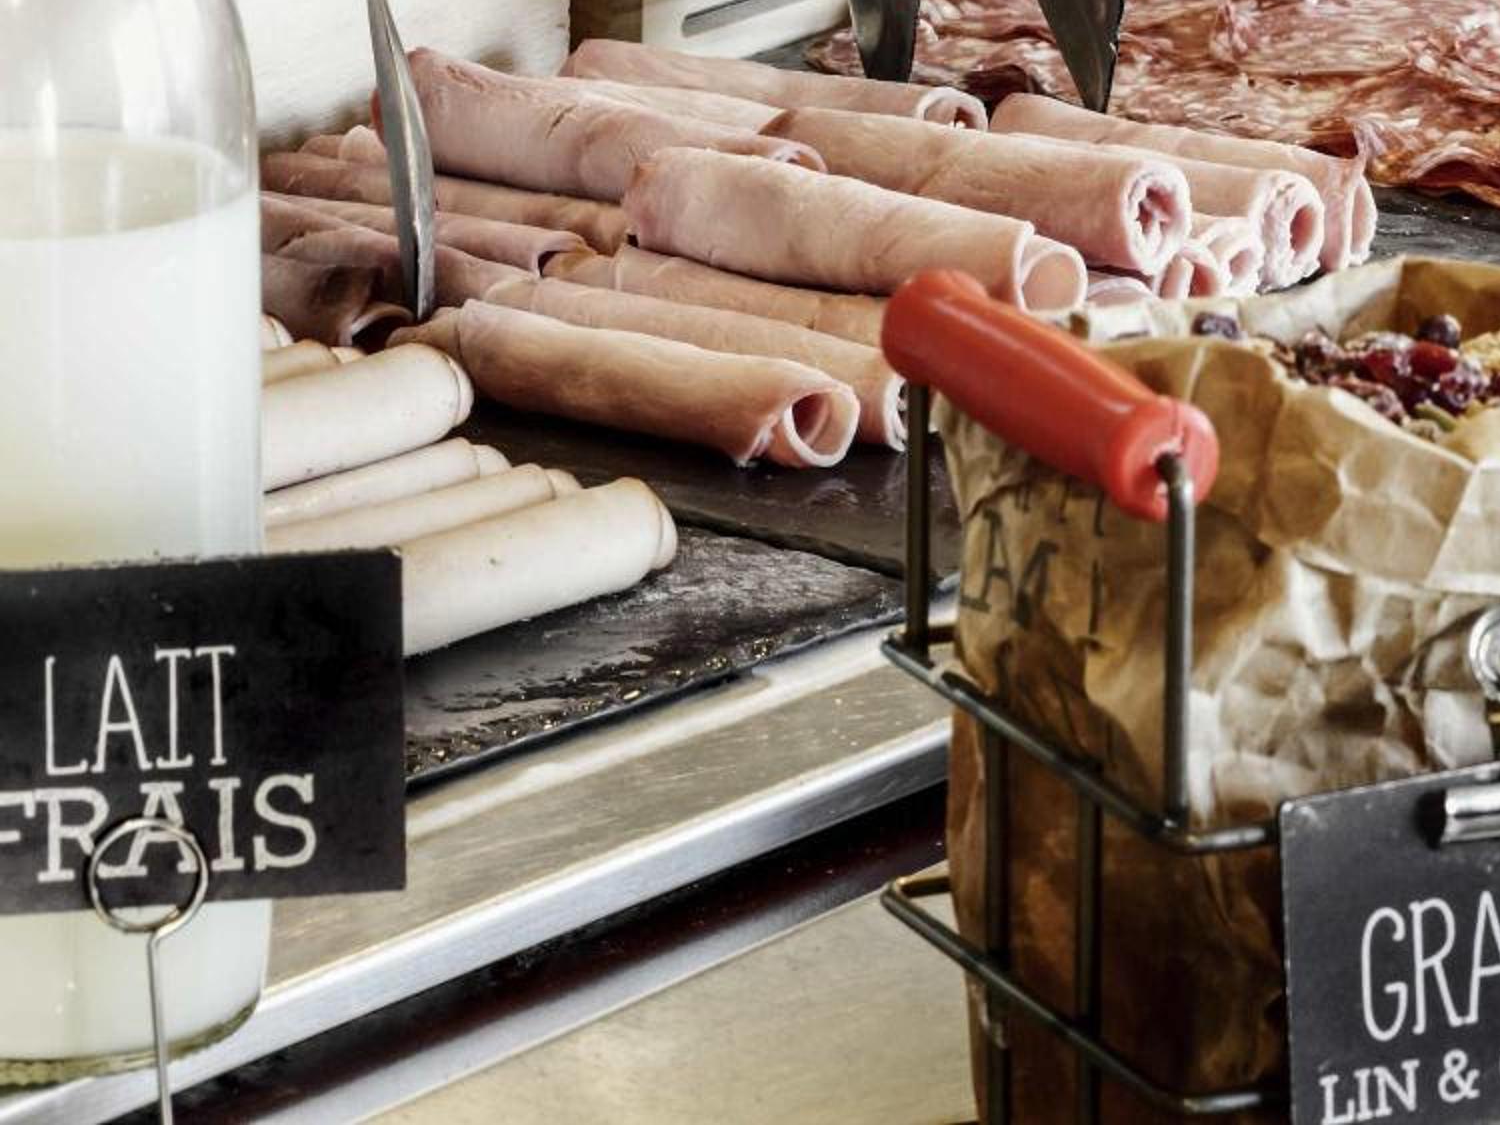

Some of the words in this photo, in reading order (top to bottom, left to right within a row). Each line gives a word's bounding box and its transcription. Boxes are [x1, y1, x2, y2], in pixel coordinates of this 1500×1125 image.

[45, 645, 236, 774] LAIT
[1319, 1059, 1420, 1125] LIN
[1437, 1049, 1480, 1103] &
